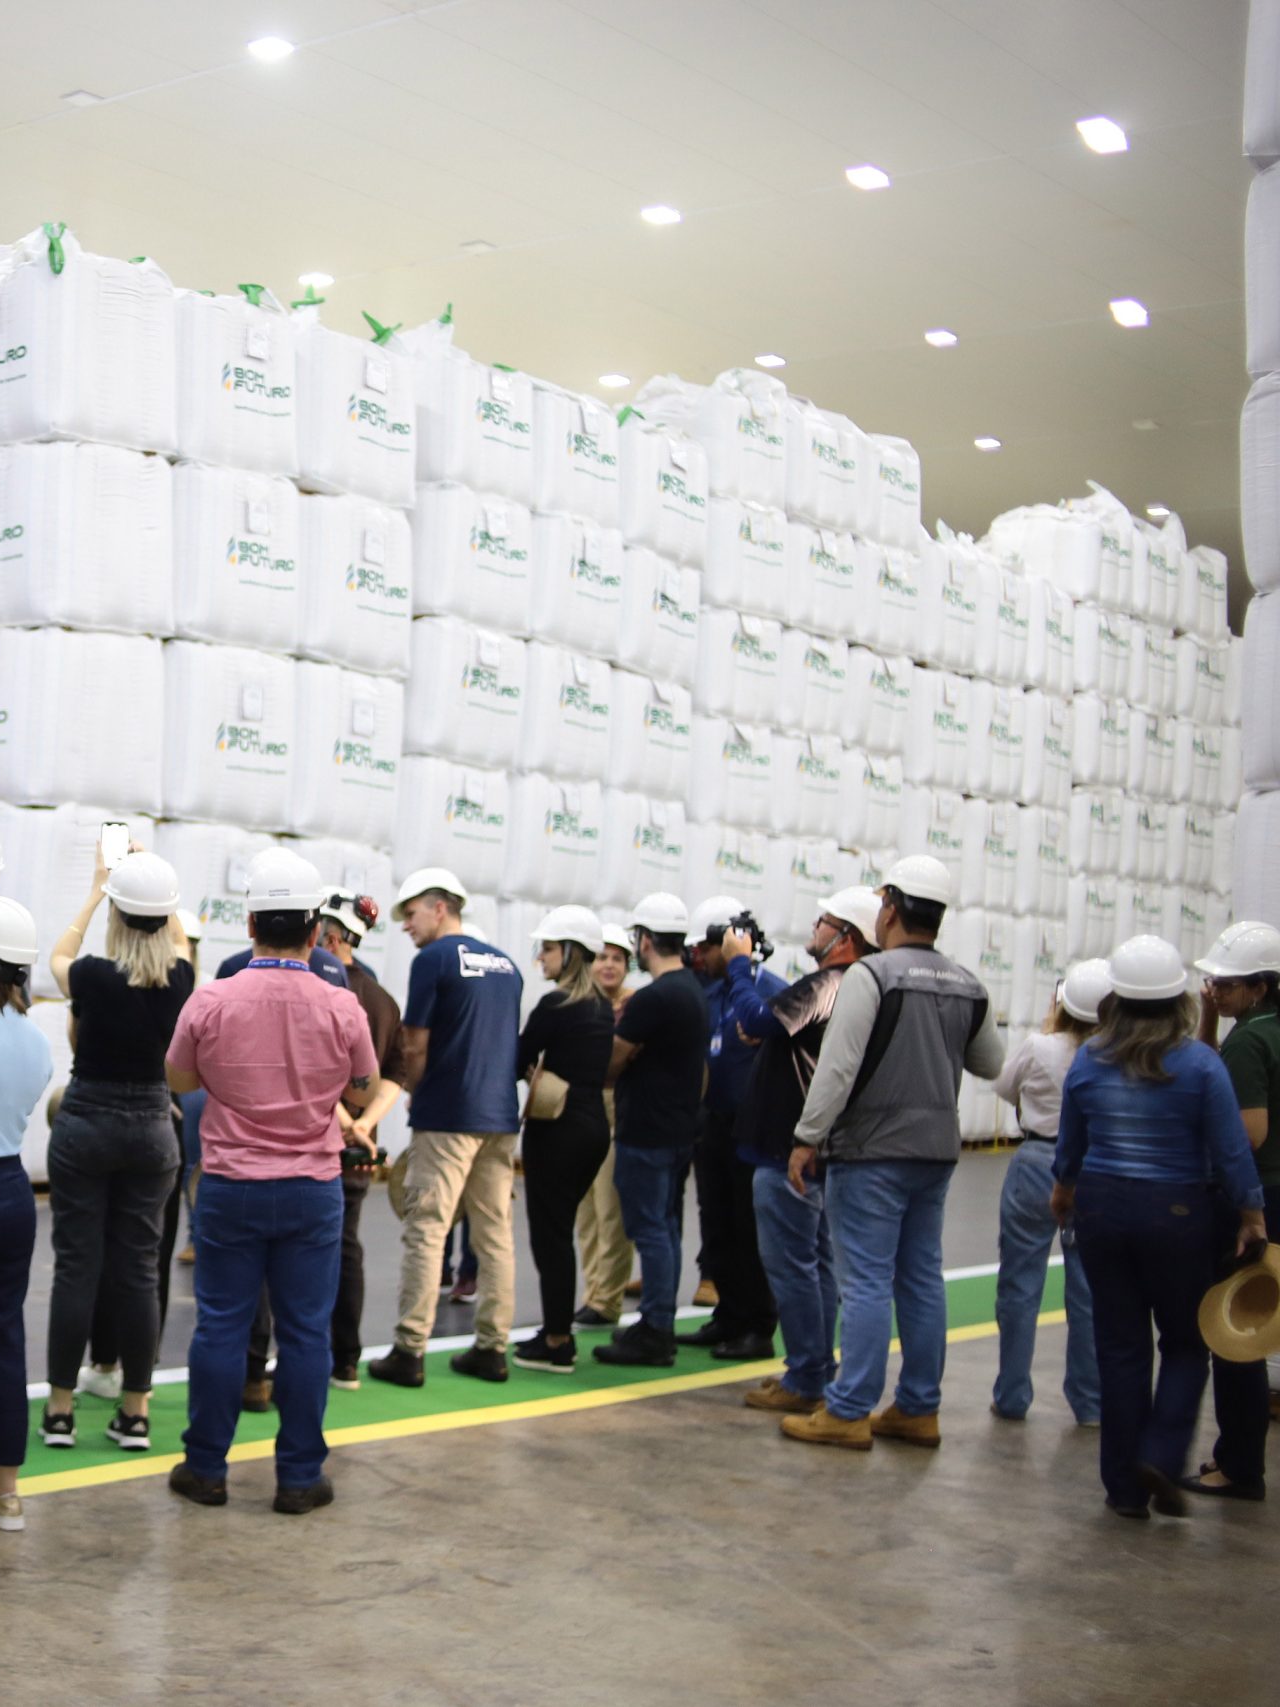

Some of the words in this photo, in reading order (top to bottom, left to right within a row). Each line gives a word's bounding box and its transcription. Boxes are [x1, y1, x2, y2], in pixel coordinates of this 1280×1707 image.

[234, 367, 264, 384] BOM
[233, 379, 291, 398] FUTURO
[358, 399, 386, 416] BOM
[358, 411, 411, 435] FUTURO
[238, 541, 269, 554] BOM
[237, 552, 296, 571] FUTURO
[357, 568, 384, 582] BOM
[356, 579, 408, 600] FUTURO
[227, 726, 259, 740] BOM
[226, 738, 287, 756] FUTURO
[343, 741, 372, 754] BOM
[342, 752, 396, 773] FUTURO
